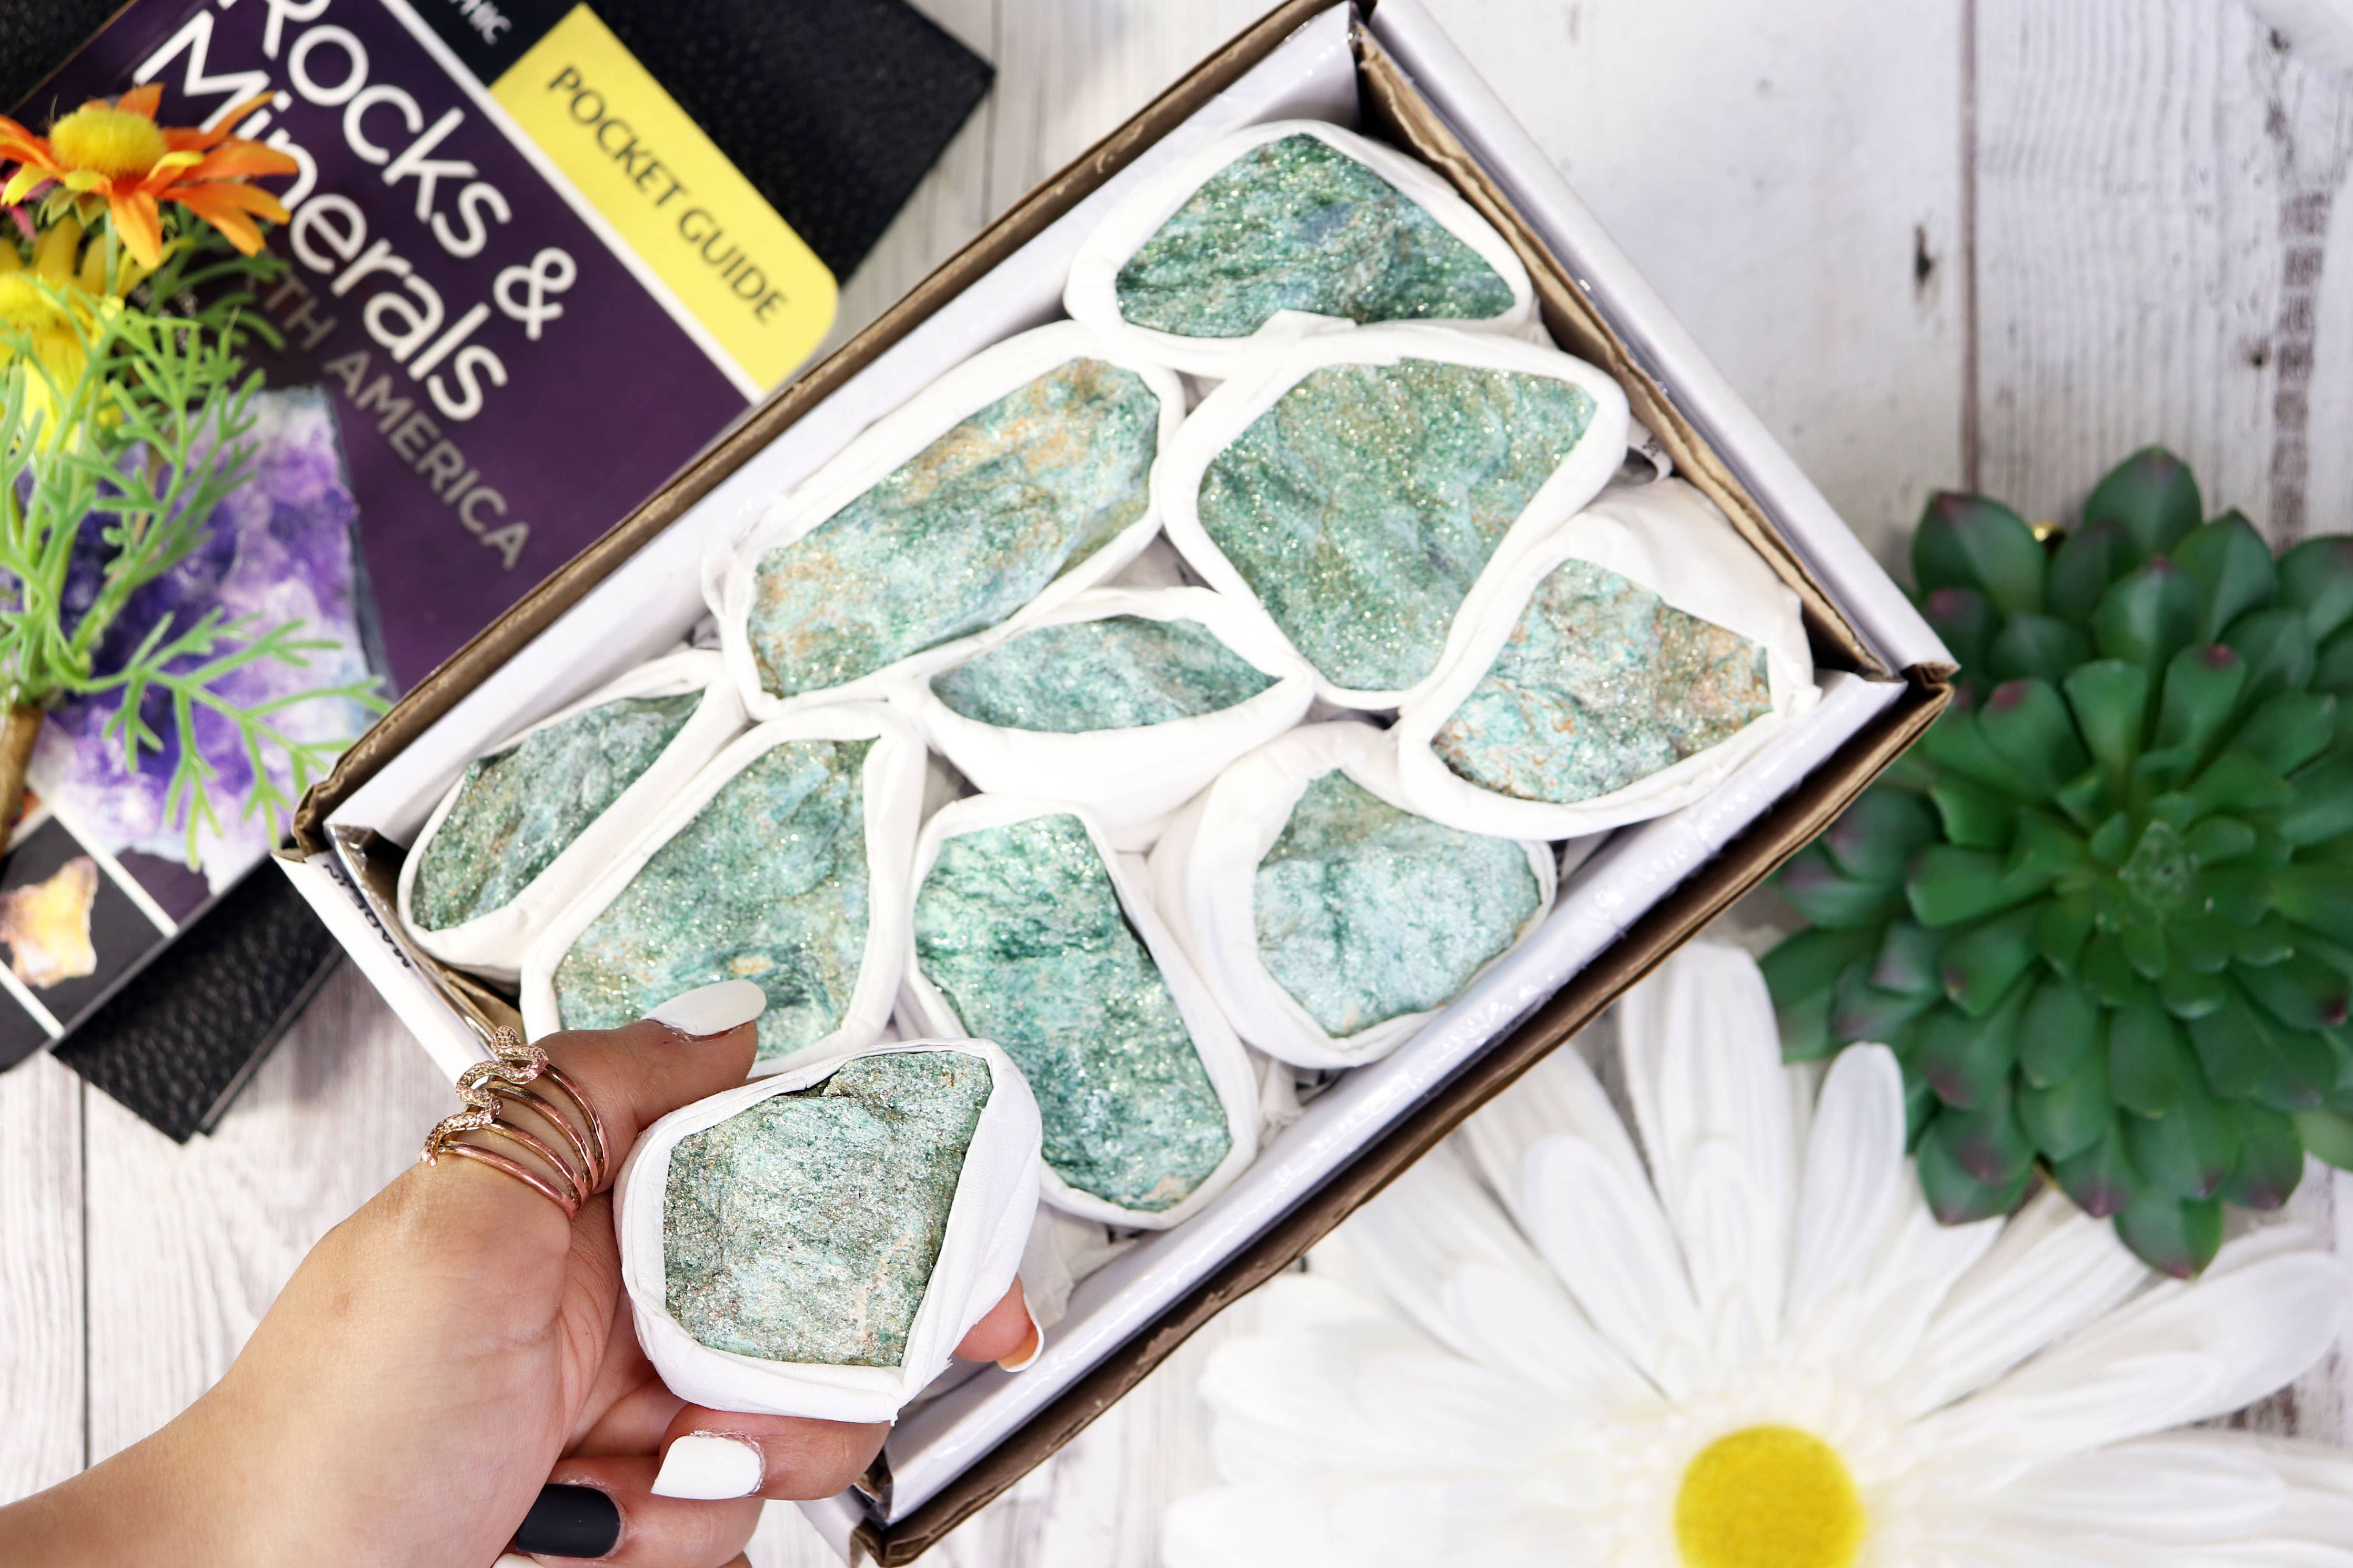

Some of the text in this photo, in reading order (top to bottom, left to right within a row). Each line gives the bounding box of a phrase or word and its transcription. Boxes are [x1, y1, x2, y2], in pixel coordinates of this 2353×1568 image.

[492, 247, 577, 340] &
[546, 65, 788, 325] POCKET GUIDE
[323, 350, 530, 571] AMERICA
